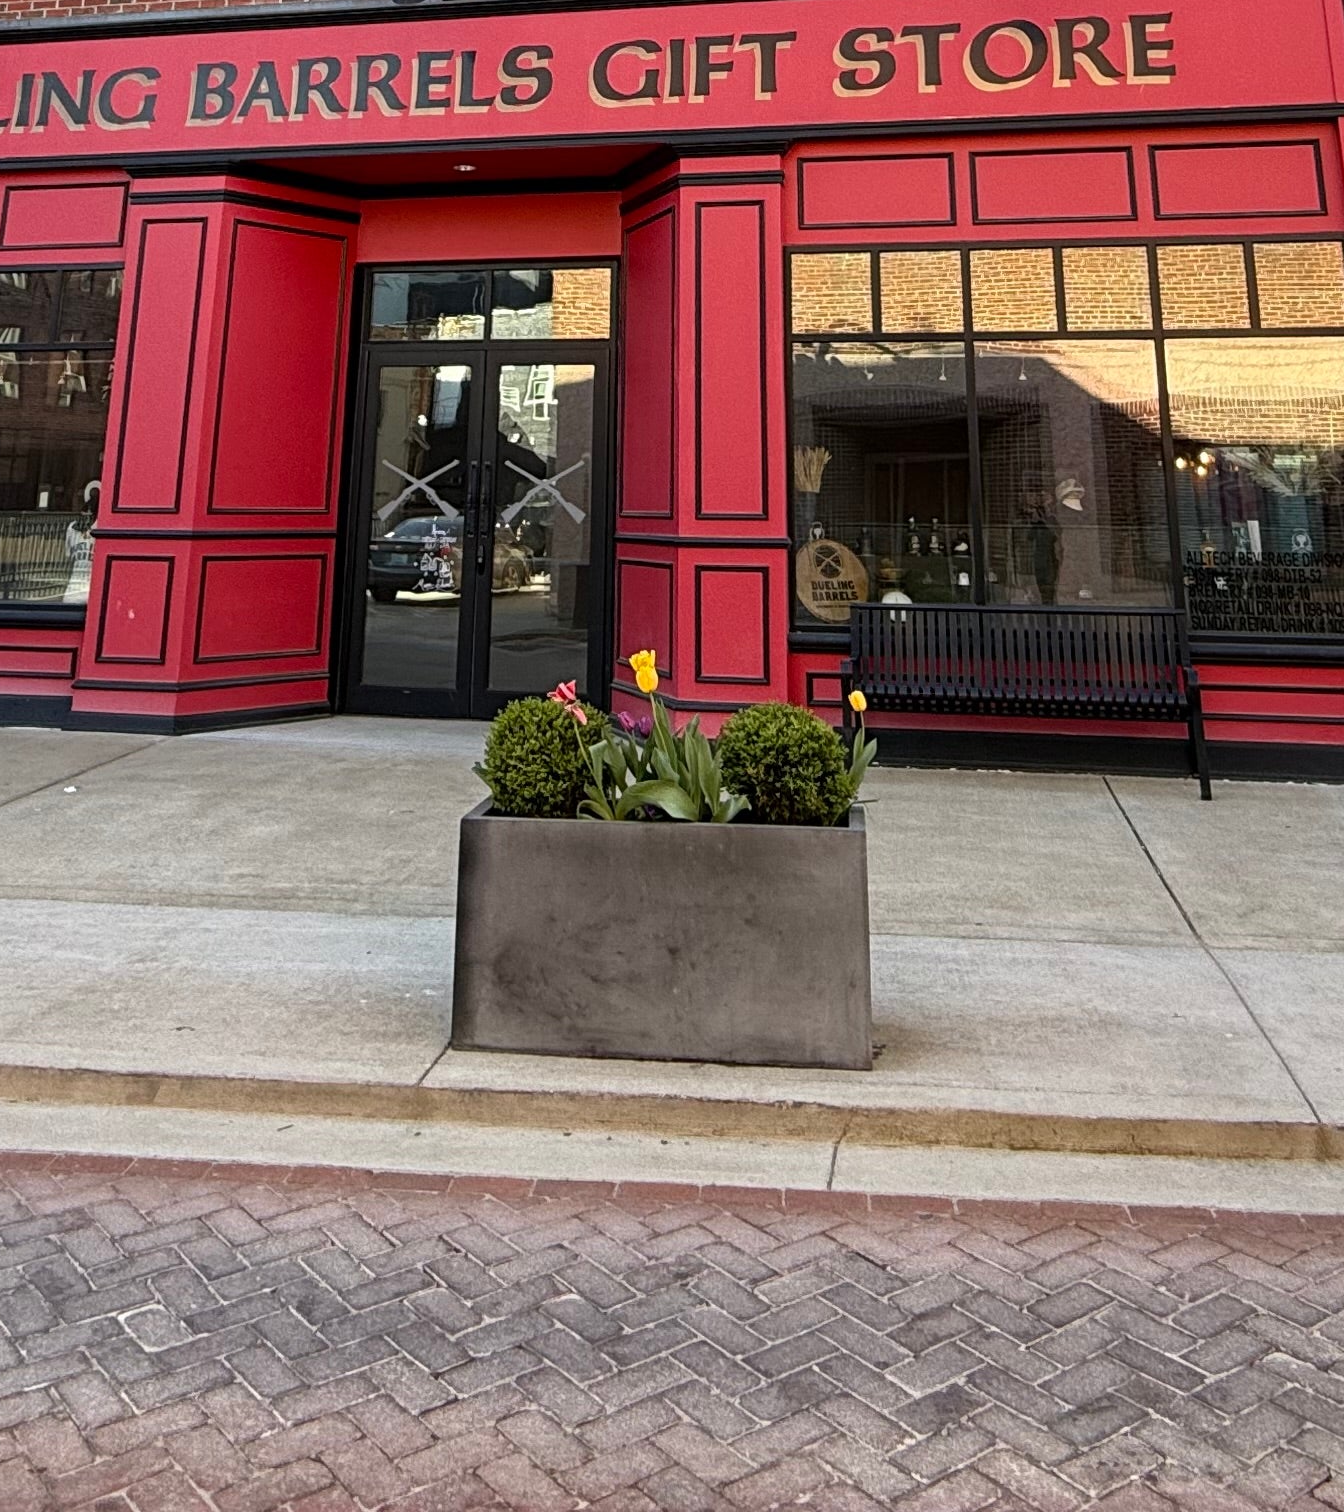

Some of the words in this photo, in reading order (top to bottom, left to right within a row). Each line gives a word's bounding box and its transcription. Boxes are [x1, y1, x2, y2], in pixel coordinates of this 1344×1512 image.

[184, 45, 554, 128] BARRELS
[588, 30, 797, 108] GIFT
[831, 12, 1176, 98] STORE
[811, 580, 856, 590] DUELING
[812, 591, 858, 601] BARRELS
